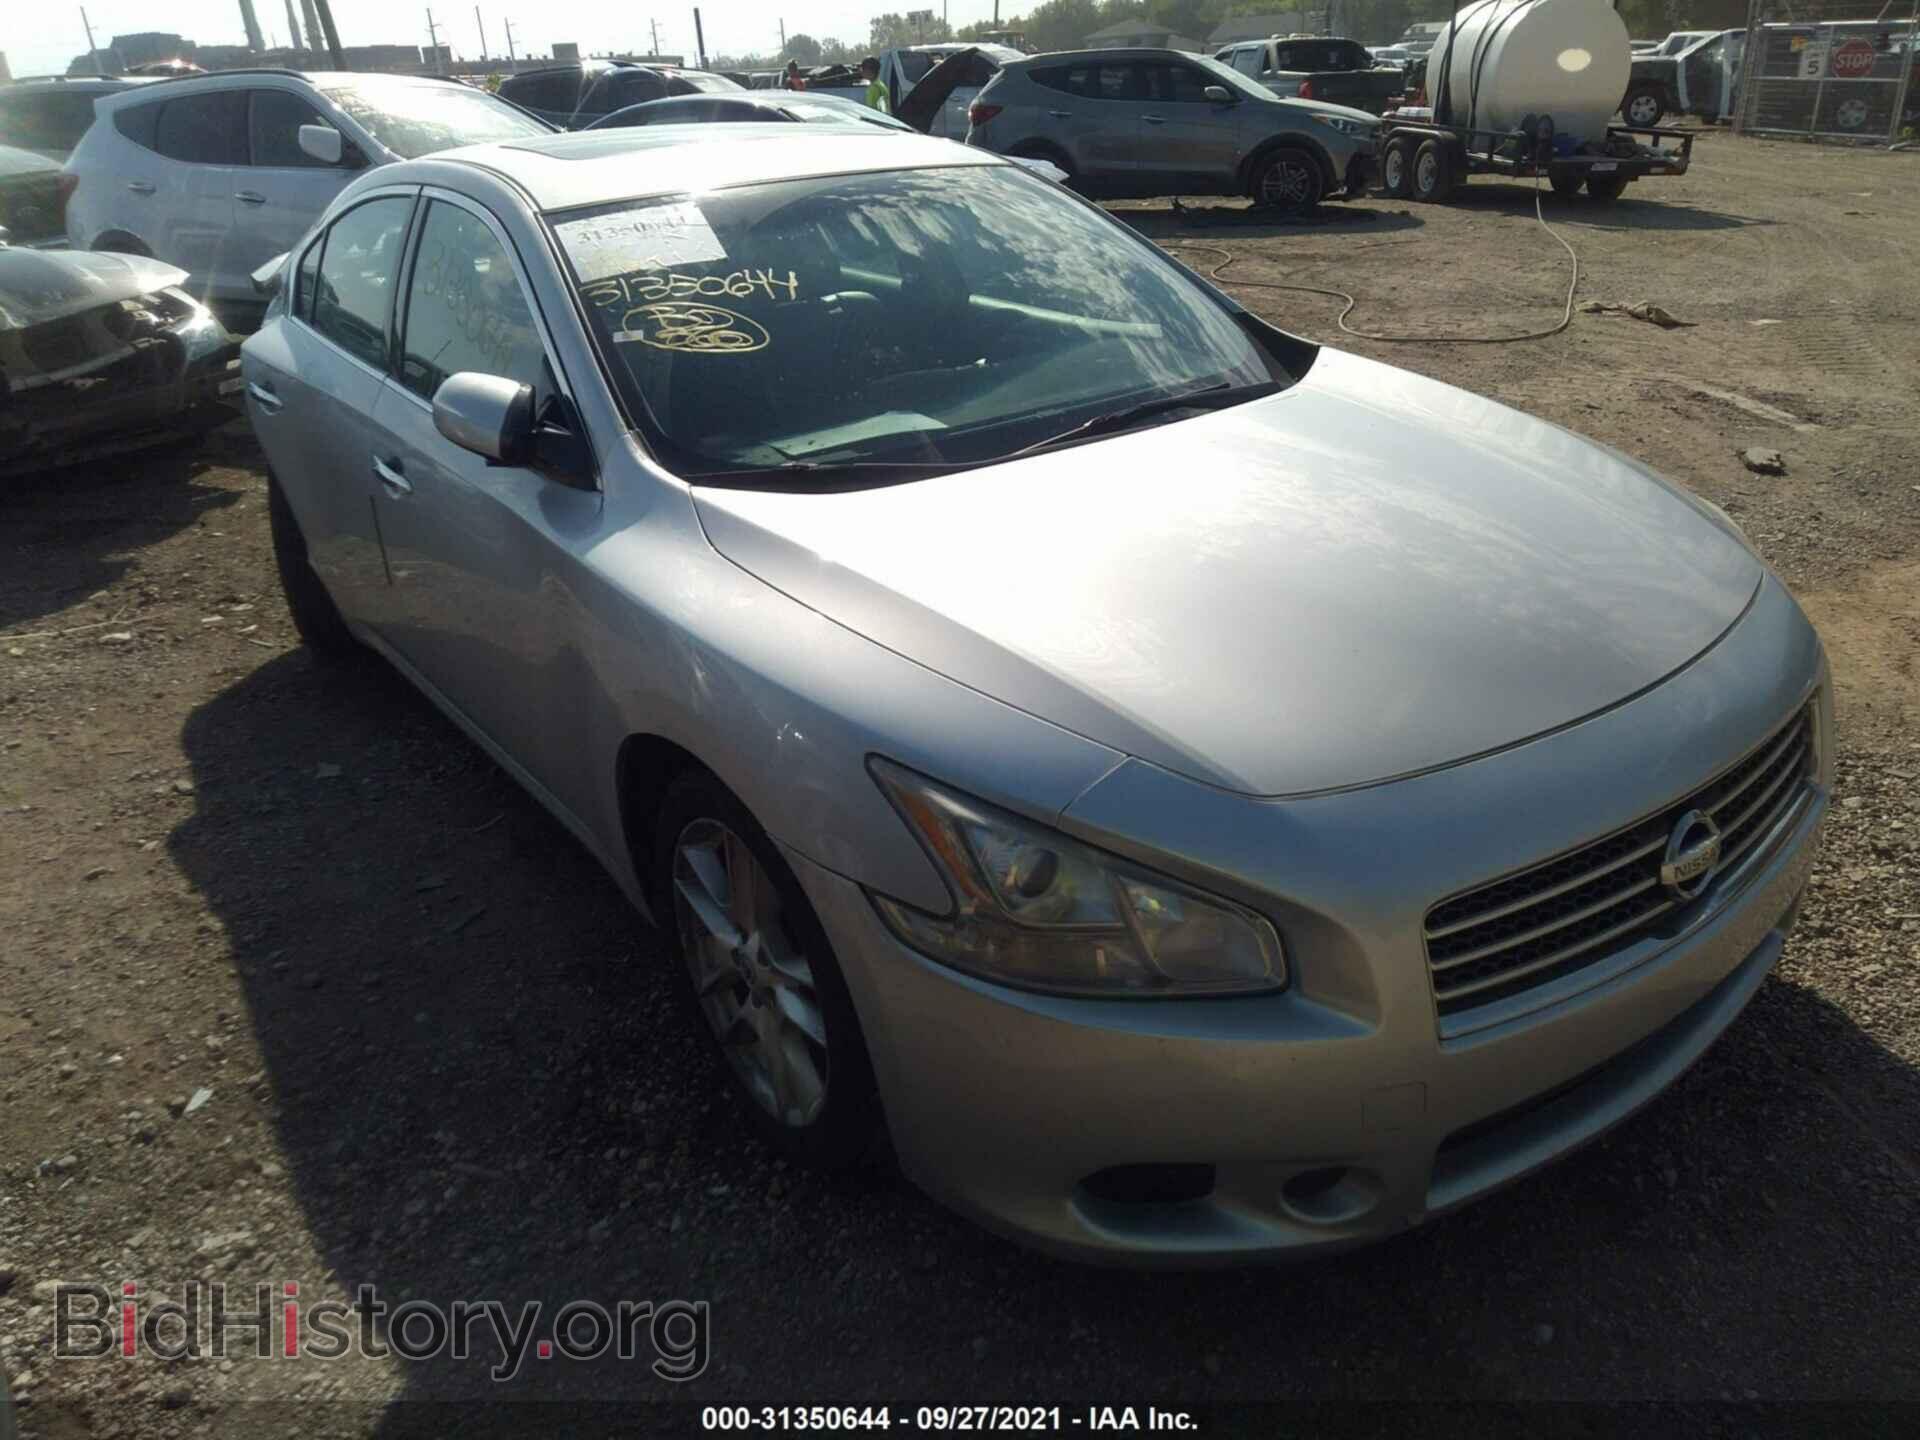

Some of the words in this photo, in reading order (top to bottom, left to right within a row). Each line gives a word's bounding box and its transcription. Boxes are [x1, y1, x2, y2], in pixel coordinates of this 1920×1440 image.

[1807, 60, 1819, 75] 5
[1837, 52, 1873, 69] STOP
[579, 268, 798, 306] 31350644
